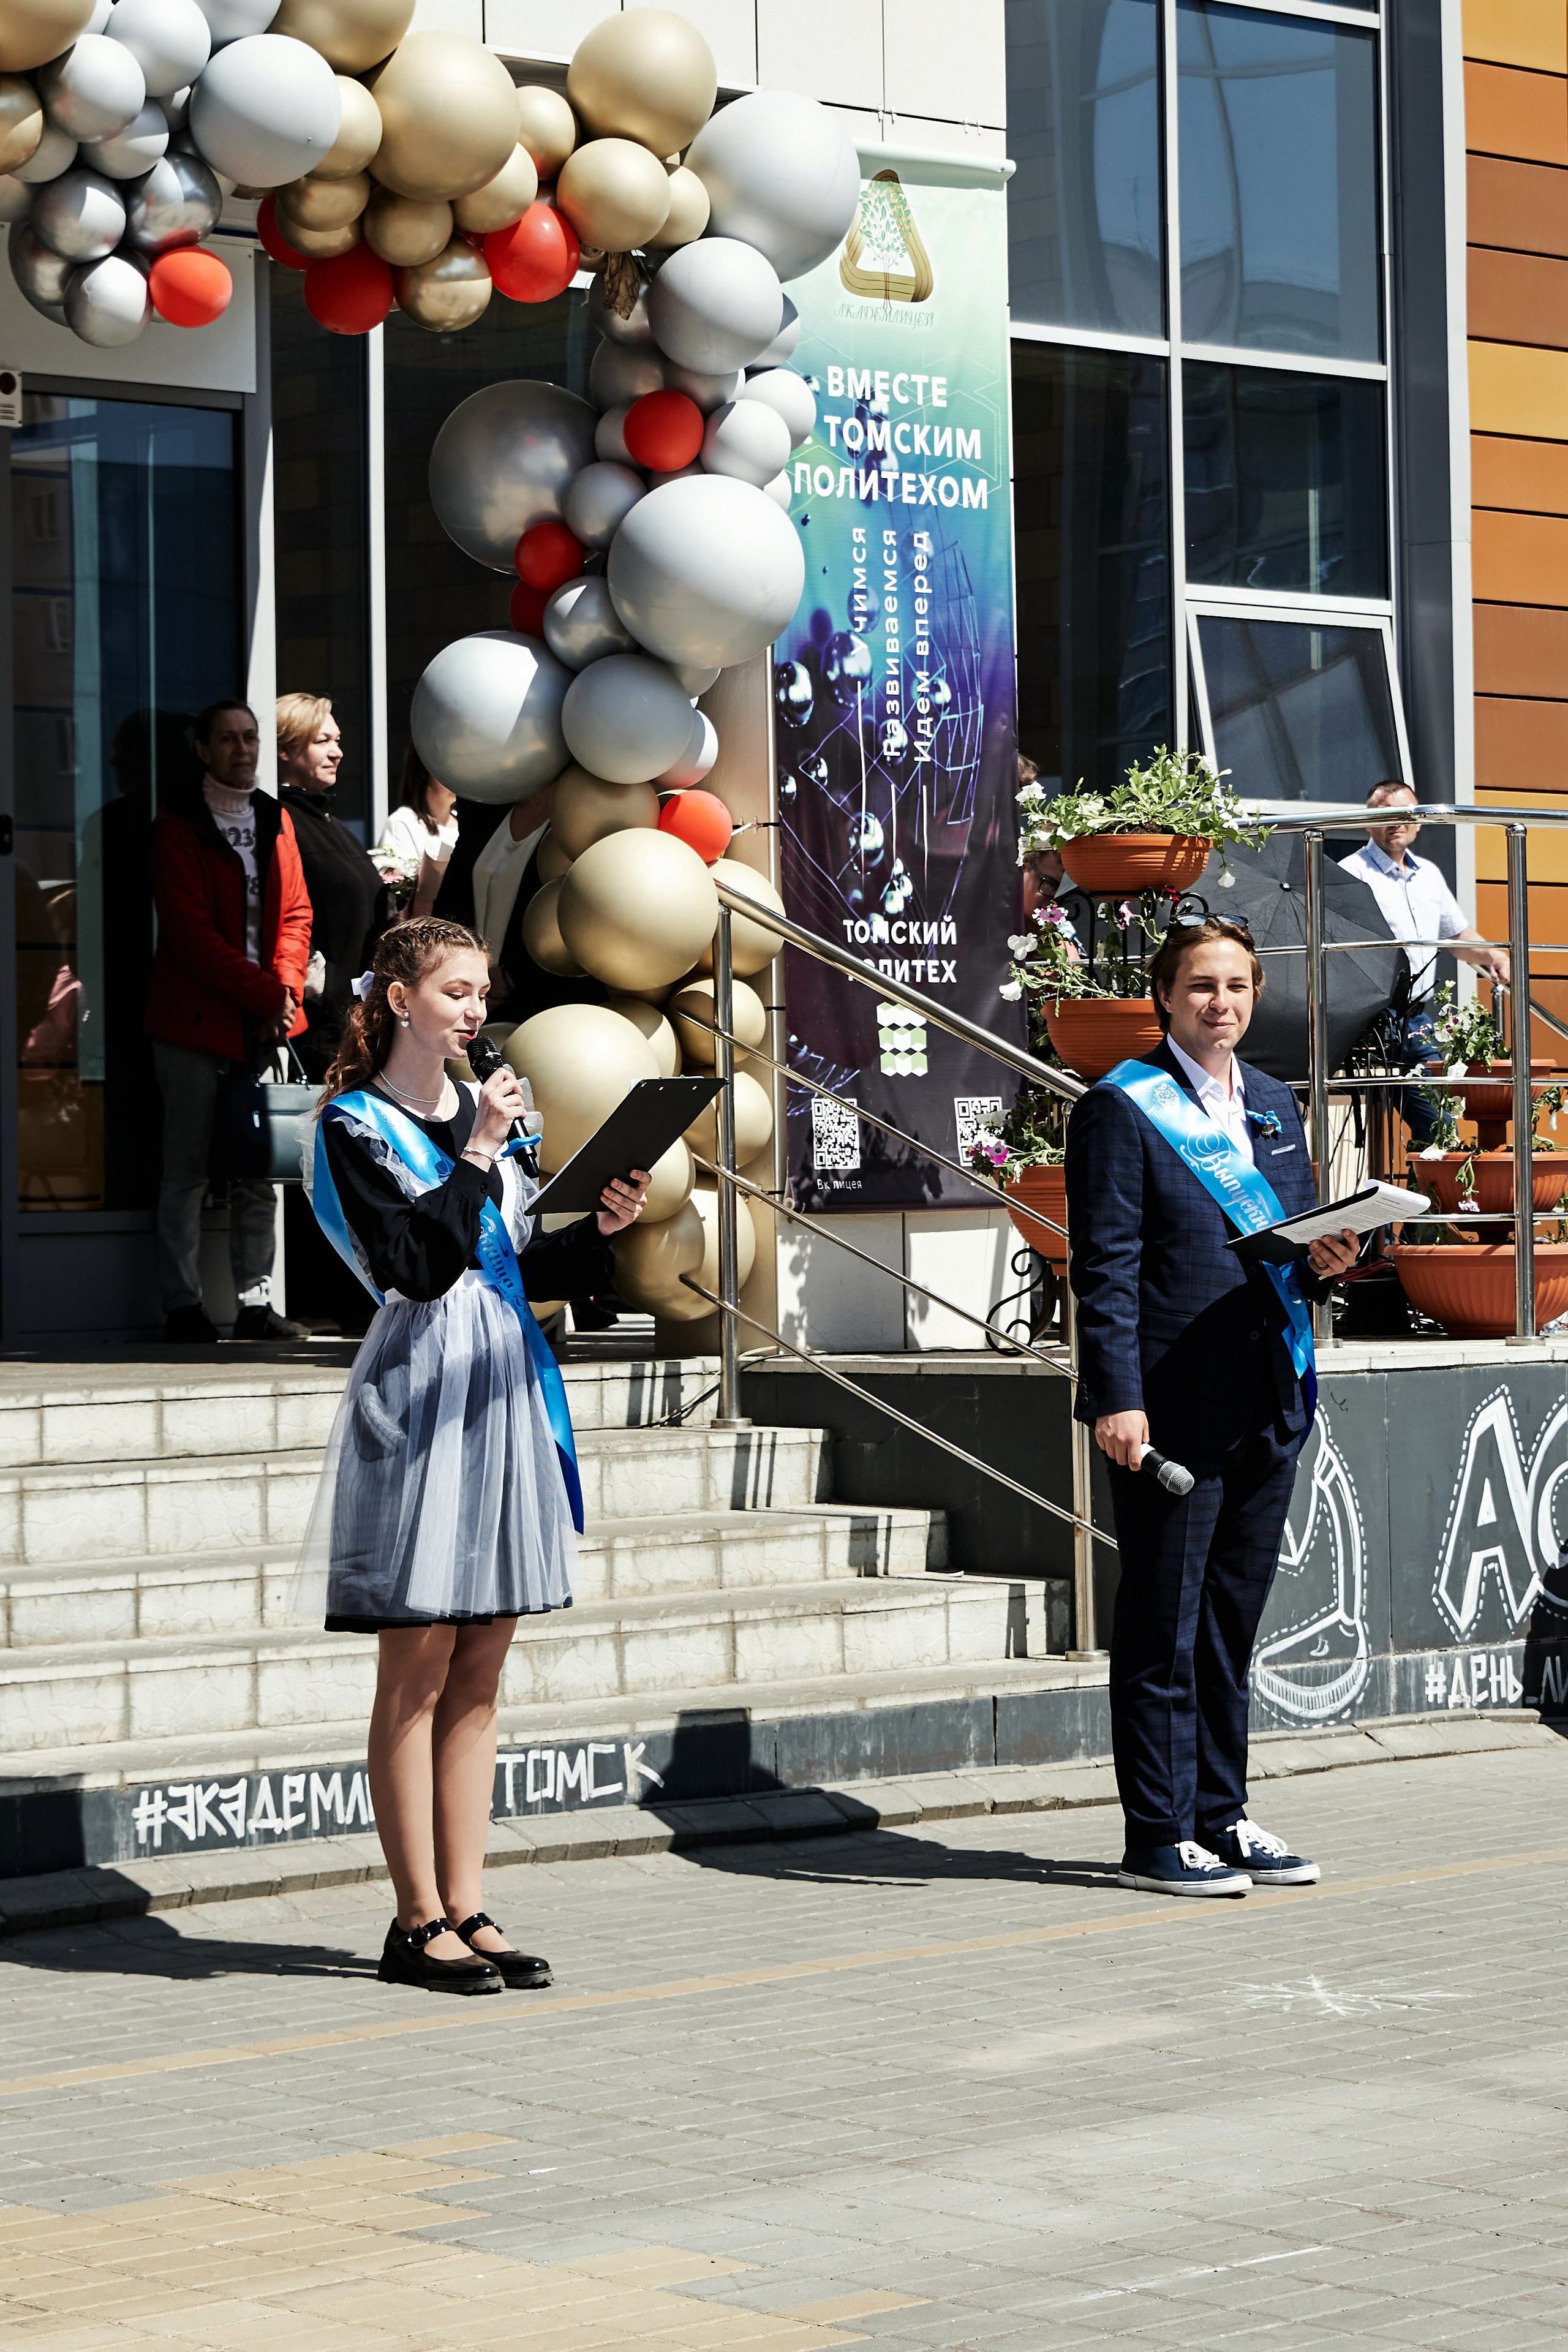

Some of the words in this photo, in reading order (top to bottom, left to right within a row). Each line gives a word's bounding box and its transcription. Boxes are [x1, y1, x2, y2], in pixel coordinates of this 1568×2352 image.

[827, 365, 947, 408] ВМЕСТЕ
[823, 415, 981, 460] ТОМСКИМ
[794, 462, 988, 510] ПОЛИТЕХОМ
[851, 527, 869, 656] Учимся
[913, 531, 932, 656] вперед
[883, 530, 900, 757] Развиваемся
[913, 671, 933, 763] Идем
[842, 914, 957, 945] ТОМСКИЙ
[848, 958, 957, 984] ЛИТЕХ
[832, 1180, 862, 1191] лицея
[1180, 1130, 1280, 1232] Выпускн
